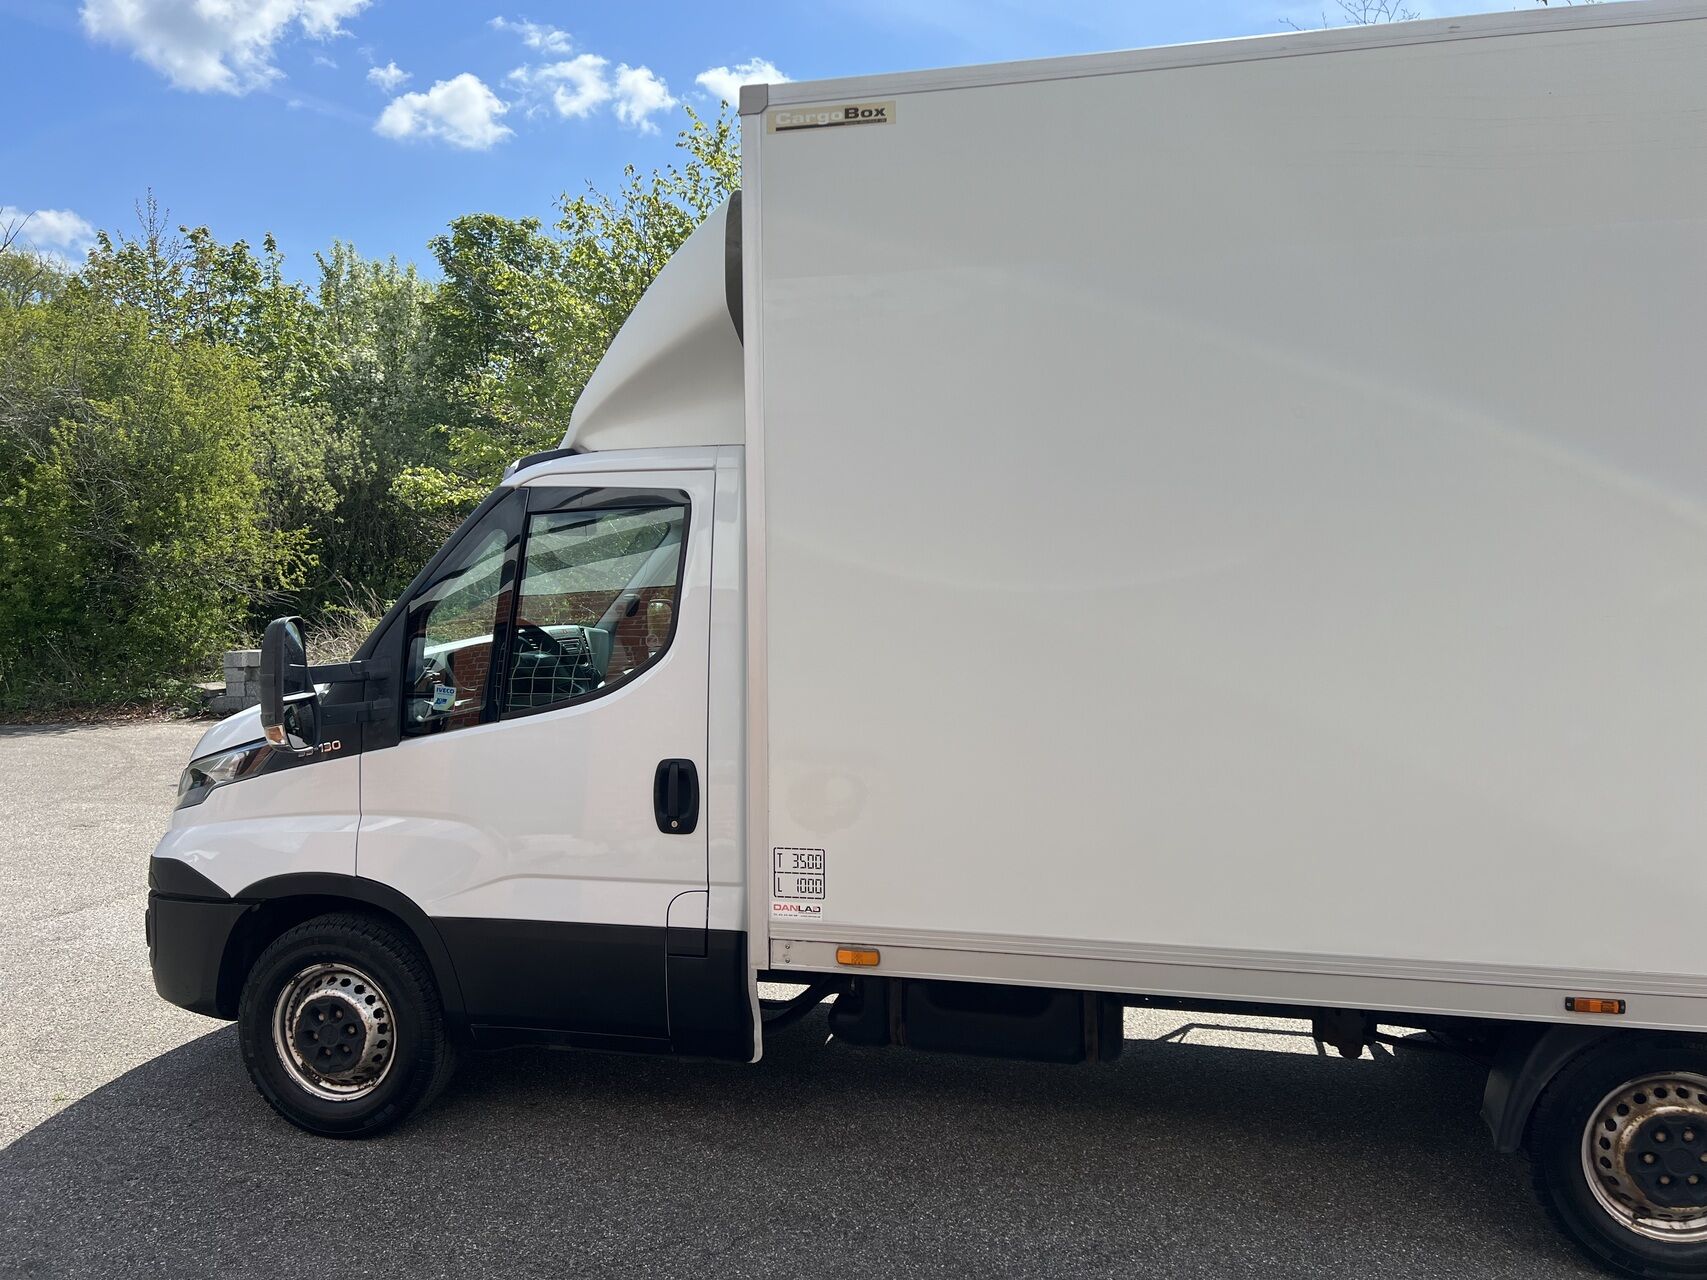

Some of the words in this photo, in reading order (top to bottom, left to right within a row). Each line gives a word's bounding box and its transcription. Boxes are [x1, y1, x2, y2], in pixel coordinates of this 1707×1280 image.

[776, 107, 886, 125] CargoBox
[777, 853, 783, 868] T
[792, 853, 822, 869] 3500
[777, 877, 783, 892] L
[796, 878, 822, 894] 1000
[773, 903, 821, 913] DANLAD
